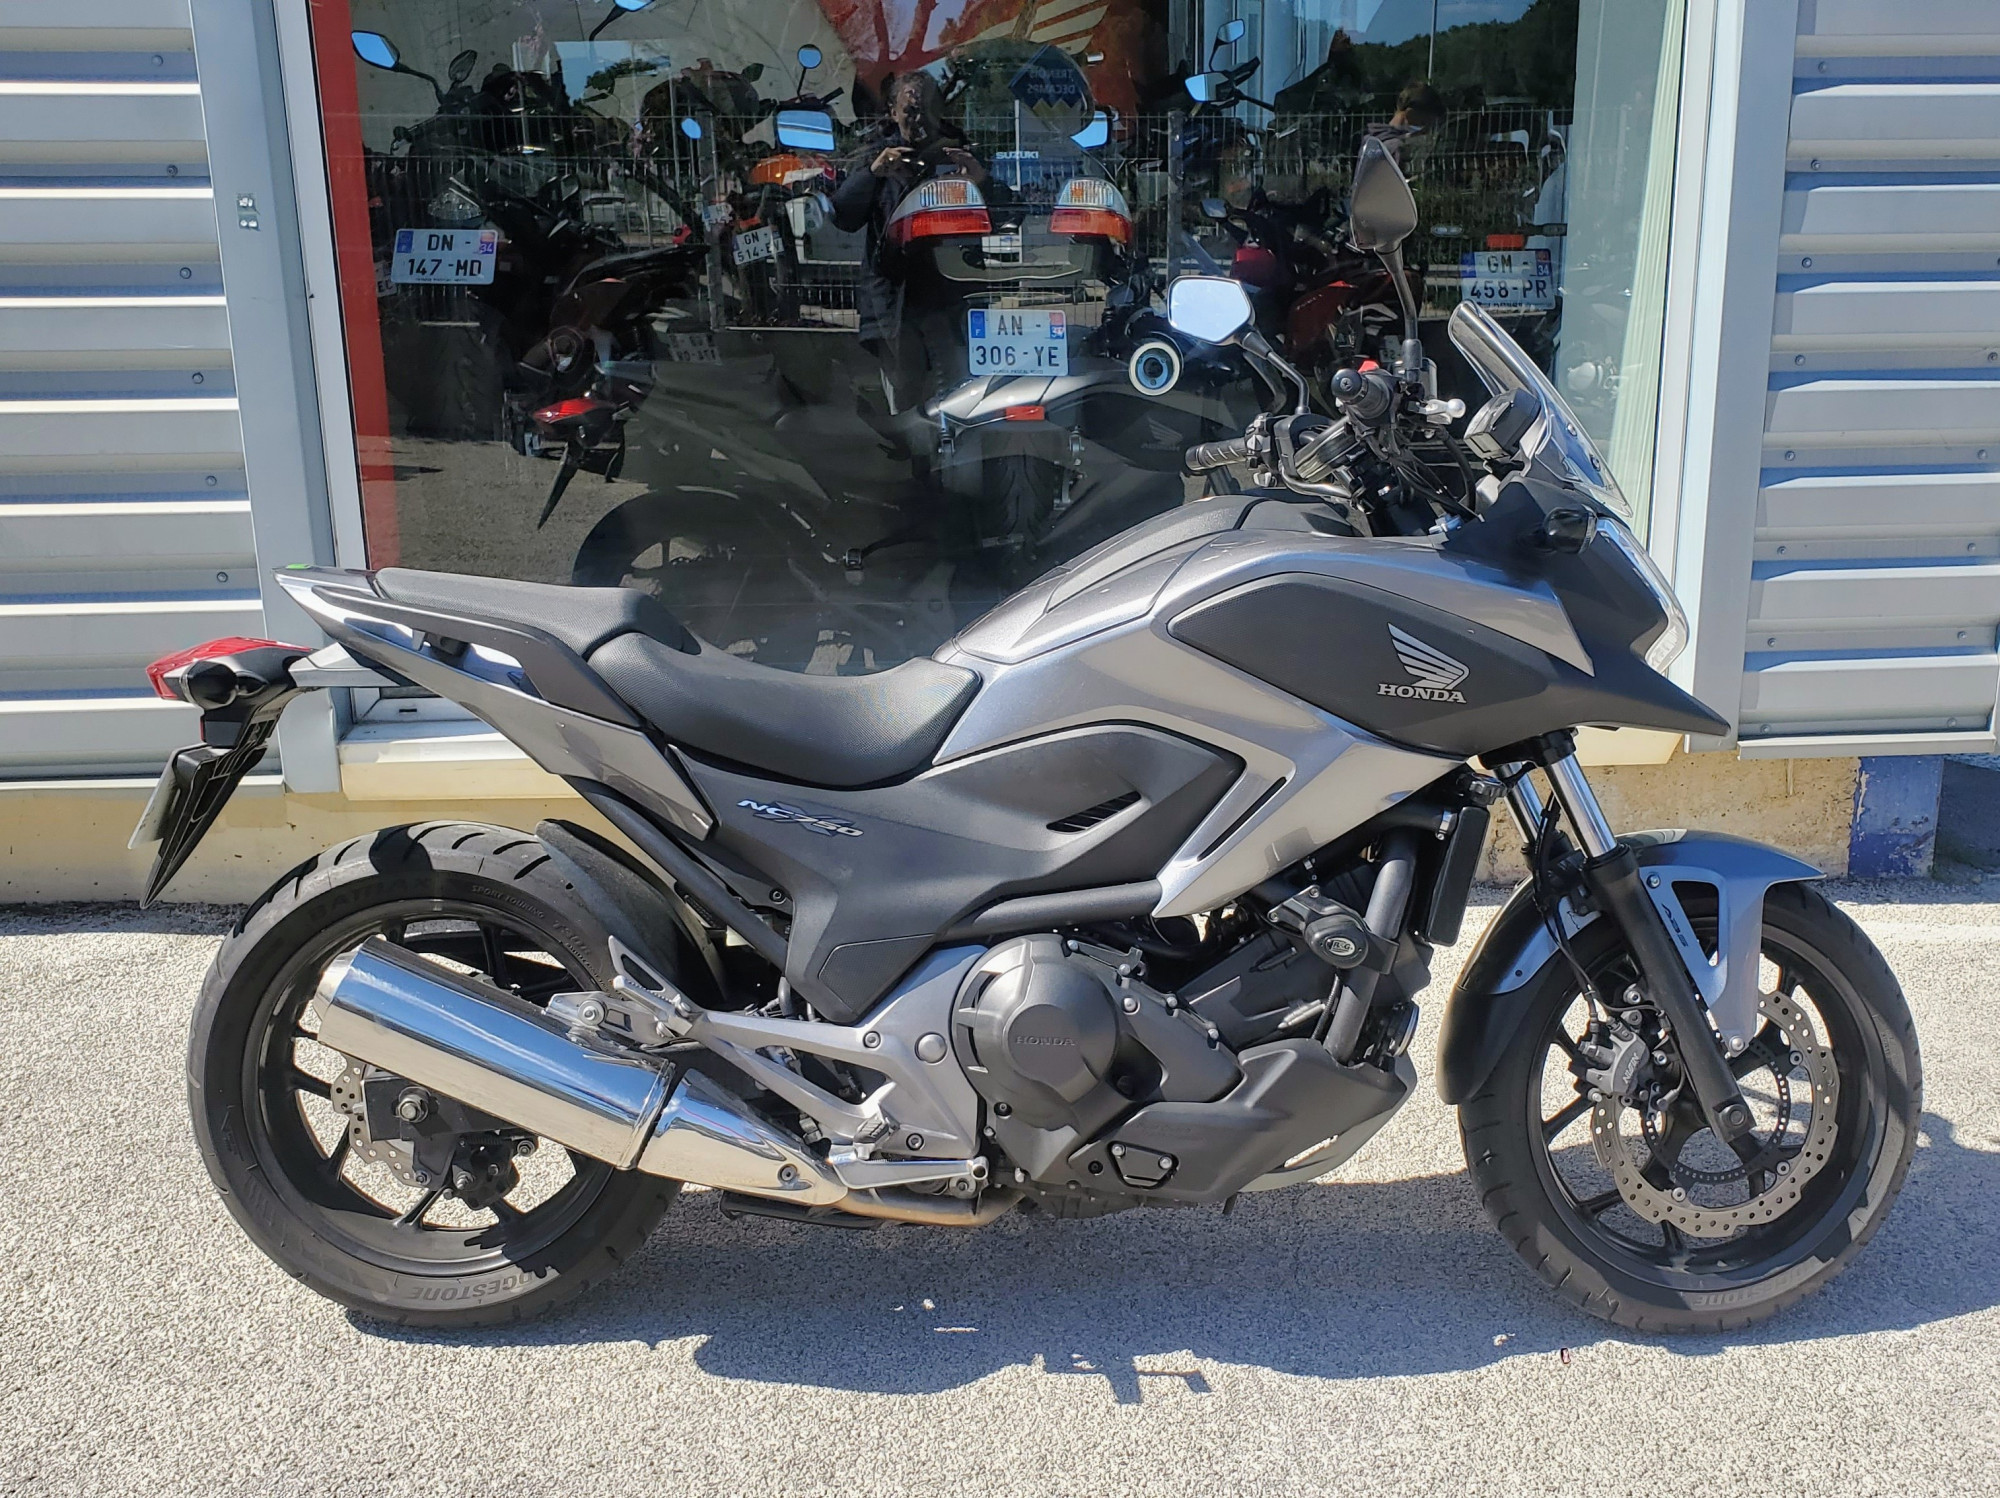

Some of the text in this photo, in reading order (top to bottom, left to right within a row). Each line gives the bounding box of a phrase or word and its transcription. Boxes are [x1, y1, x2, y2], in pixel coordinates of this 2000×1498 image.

[995, 151, 1039, 159] SUZUKI
[408, 259, 482, 276] 147-MD
[1538, 265, 1550, 276] 34
[1470, 279, 1547, 299] 458-PR
[975, 345, 1060, 367] 306-YE
[1376, 683, 1467, 704] HONDA
[472, 884, 502, 899] SPORT
[505, 894, 545, 919] TOURING
[1661, 903, 1688, 947] ABS
[1016, 1036, 1075, 1046] HONDA
[407, 1271, 533, 1301] DGESTONE
